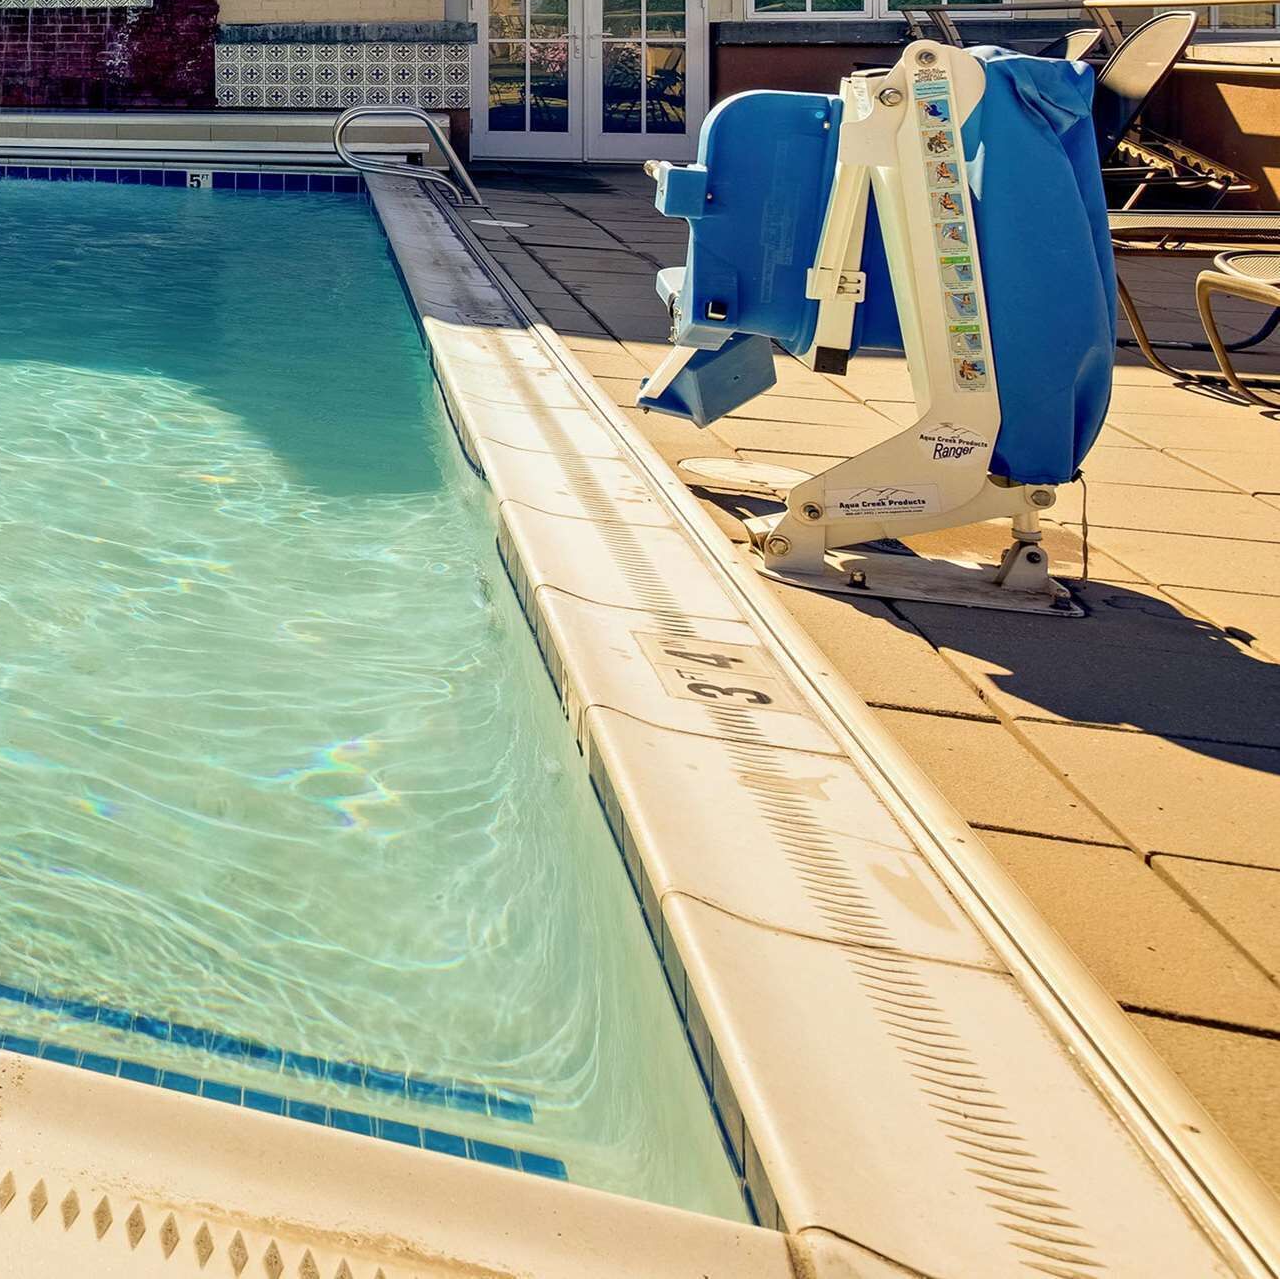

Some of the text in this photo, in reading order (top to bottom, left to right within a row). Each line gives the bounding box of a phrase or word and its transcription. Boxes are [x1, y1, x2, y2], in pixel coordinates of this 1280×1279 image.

[190, 173, 201, 188] 5
[919, 433, 988, 448] Aqua Creek Products
[933, 443, 974, 460] Ranger
[888, 498, 926, 506] Products
[687, 682, 772, 705] 3
